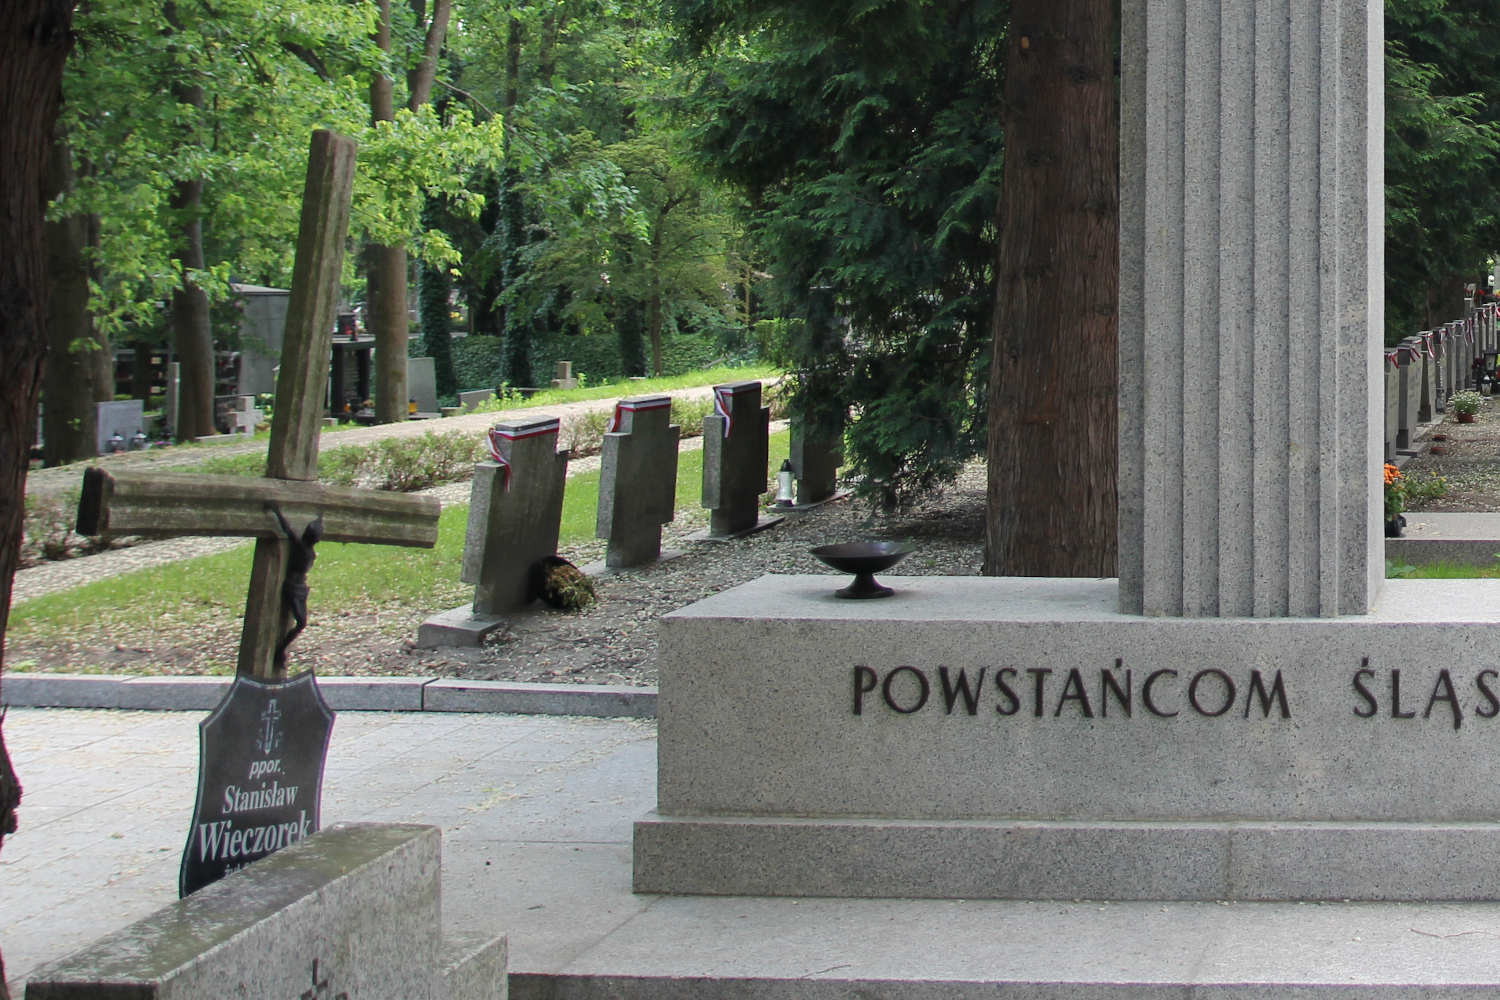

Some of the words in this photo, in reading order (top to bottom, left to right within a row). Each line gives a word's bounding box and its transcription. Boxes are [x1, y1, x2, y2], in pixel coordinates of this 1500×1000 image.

[851, 658, 1292, 719] POWSTAŃCOM
[249, 758, 282, 780] ppor.
[223, 781, 300, 814] Stanisław
[200, 810, 312, 863] Wieczorek
